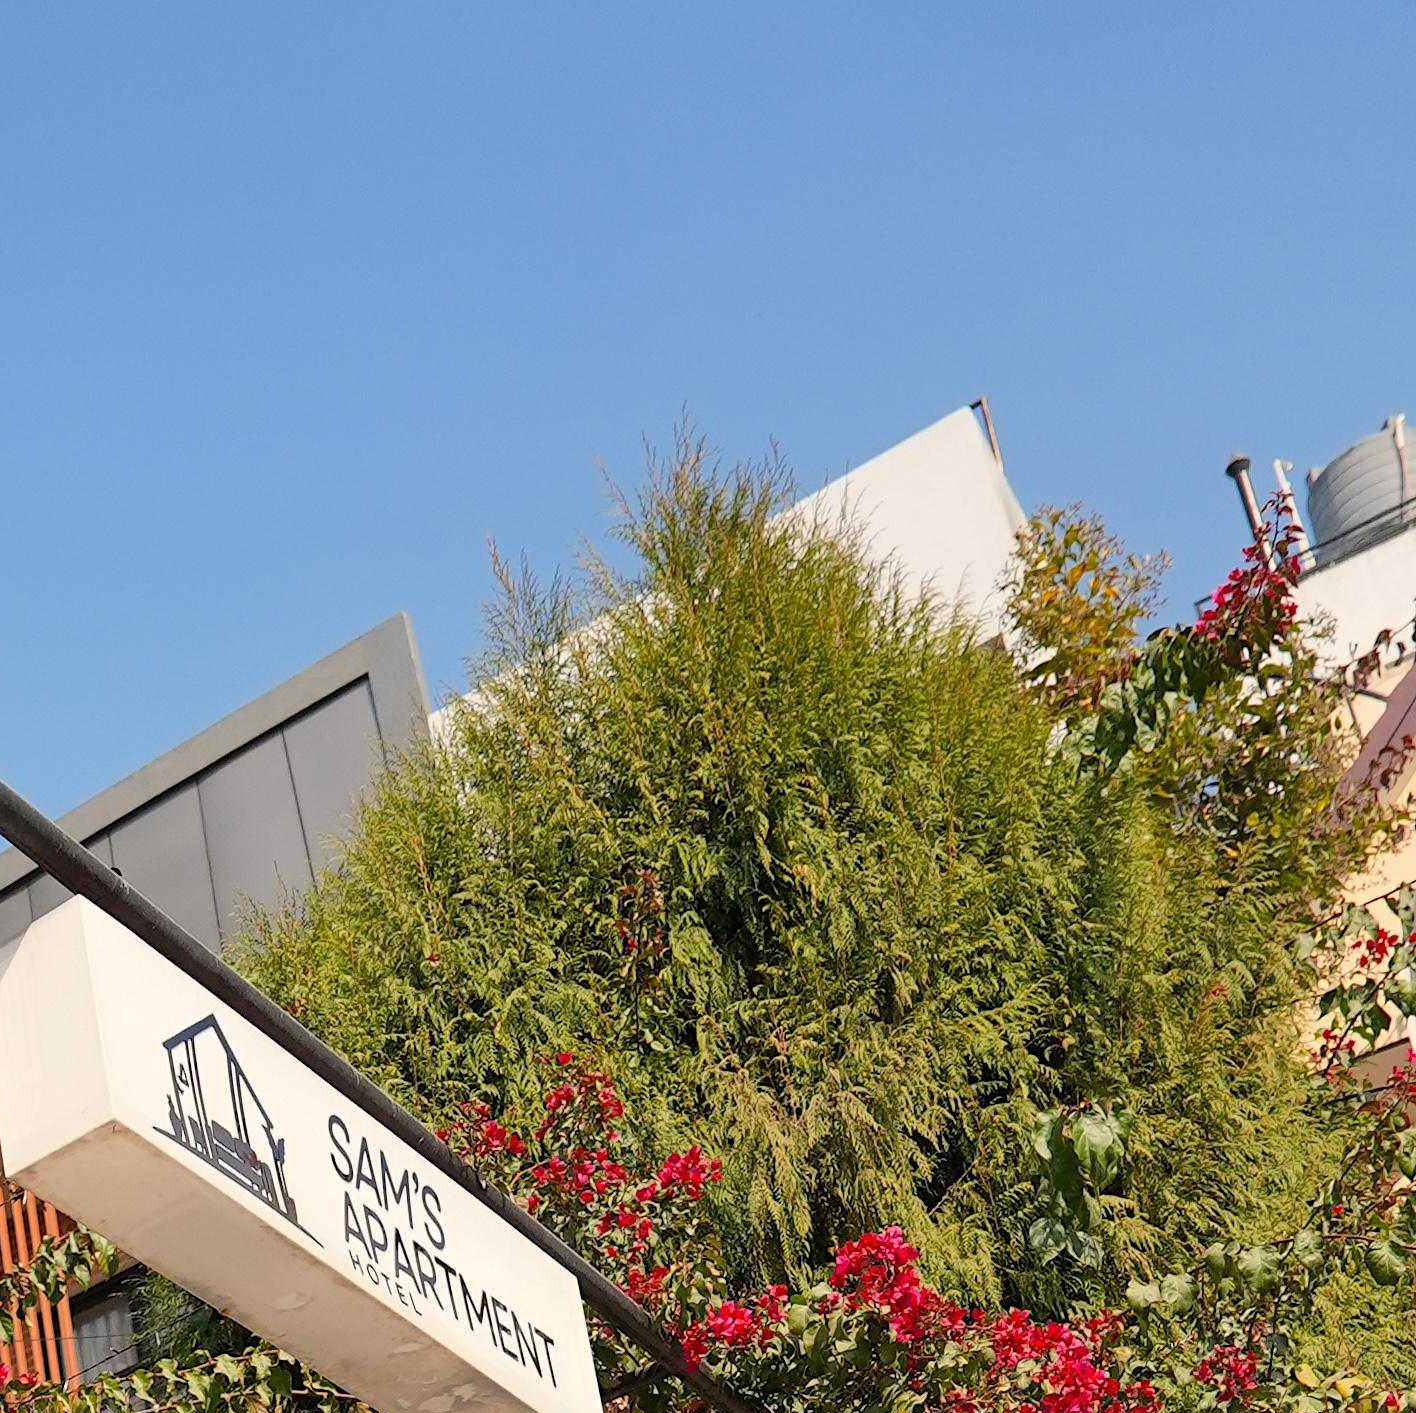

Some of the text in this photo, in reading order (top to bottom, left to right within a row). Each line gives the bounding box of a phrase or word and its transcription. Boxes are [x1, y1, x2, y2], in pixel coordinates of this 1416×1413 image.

[328, 1114, 445, 1250] SAM'S
[344, 1190, 557, 1389] APARTMENT
[348, 1248, 423, 1317] HOTEL
